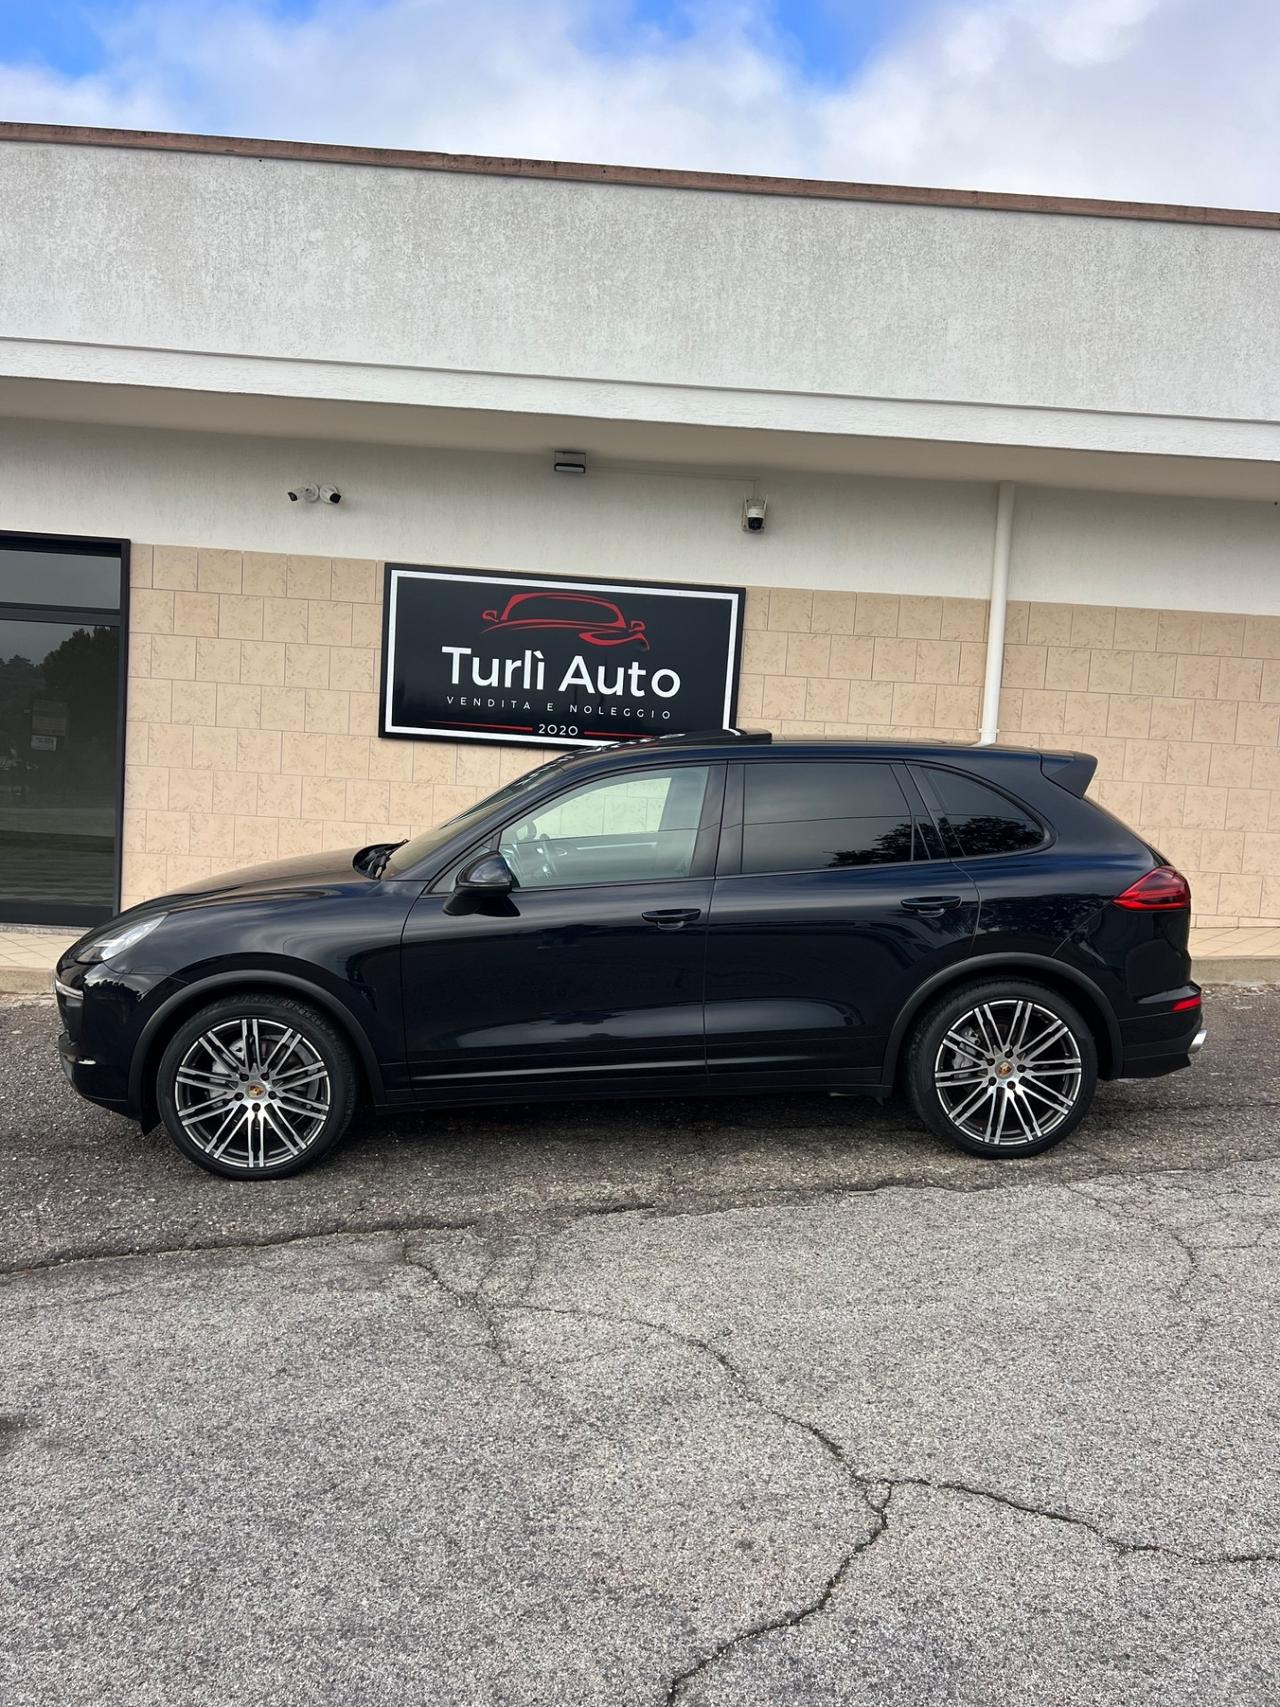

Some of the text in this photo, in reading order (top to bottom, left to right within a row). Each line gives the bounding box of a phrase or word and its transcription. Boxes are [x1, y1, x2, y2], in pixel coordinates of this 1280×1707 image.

[441, 646, 681, 698] Turlì Auto
[446, 695, 671, 720] VENDITA E NOLEGGIO
[538, 723, 579, 736] 2020
